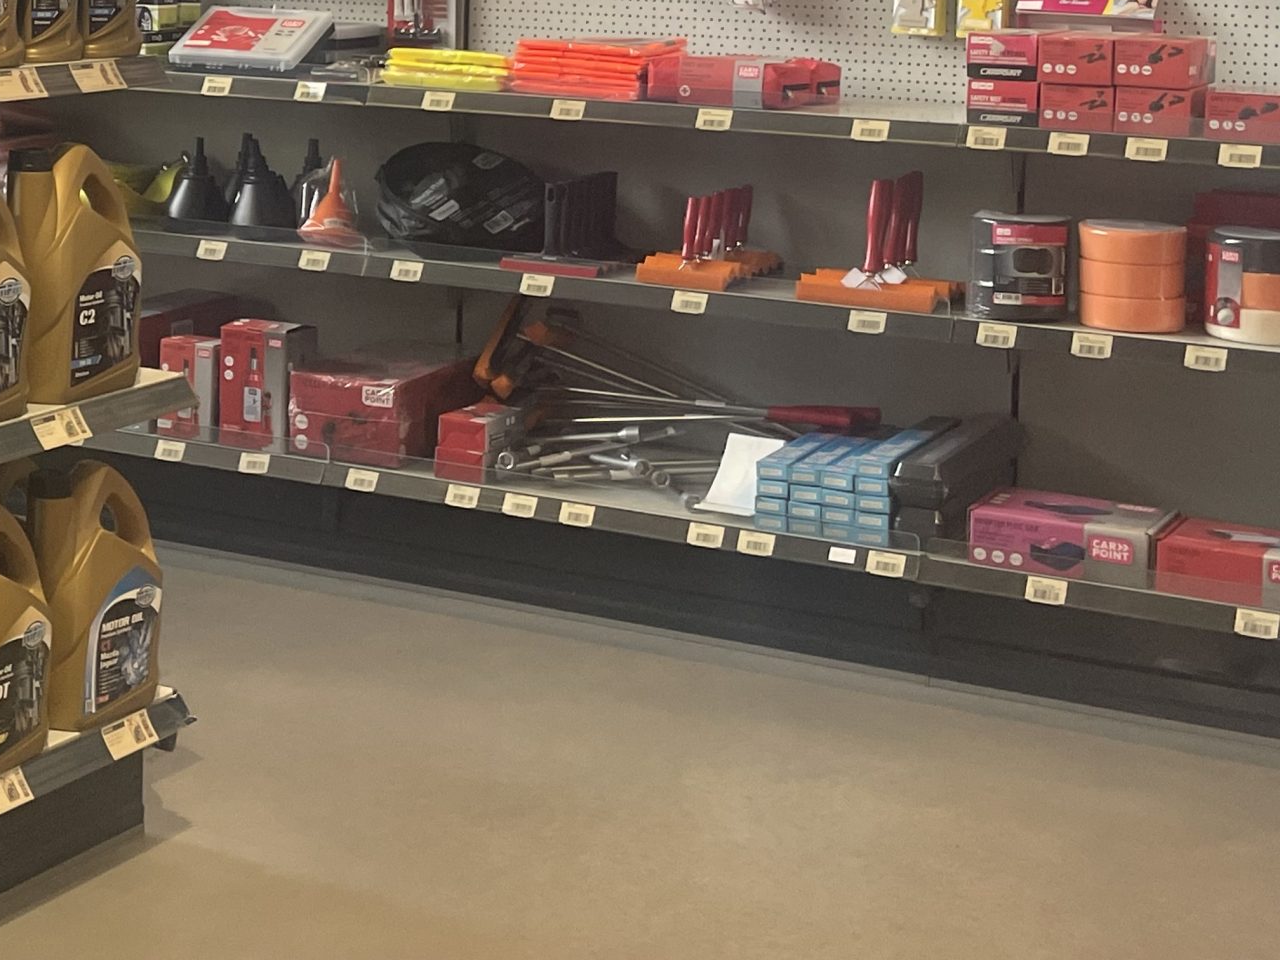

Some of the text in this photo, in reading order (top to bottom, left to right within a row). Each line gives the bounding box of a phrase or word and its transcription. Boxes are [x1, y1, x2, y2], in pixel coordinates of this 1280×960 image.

[79, 294, 94, 302] Motor
[79, 309, 96, 326] C2
[1093, 540, 1118, 549] CAR
[1093, 549, 1128, 560] POINT
[102, 616, 130, 632] MOTOR
